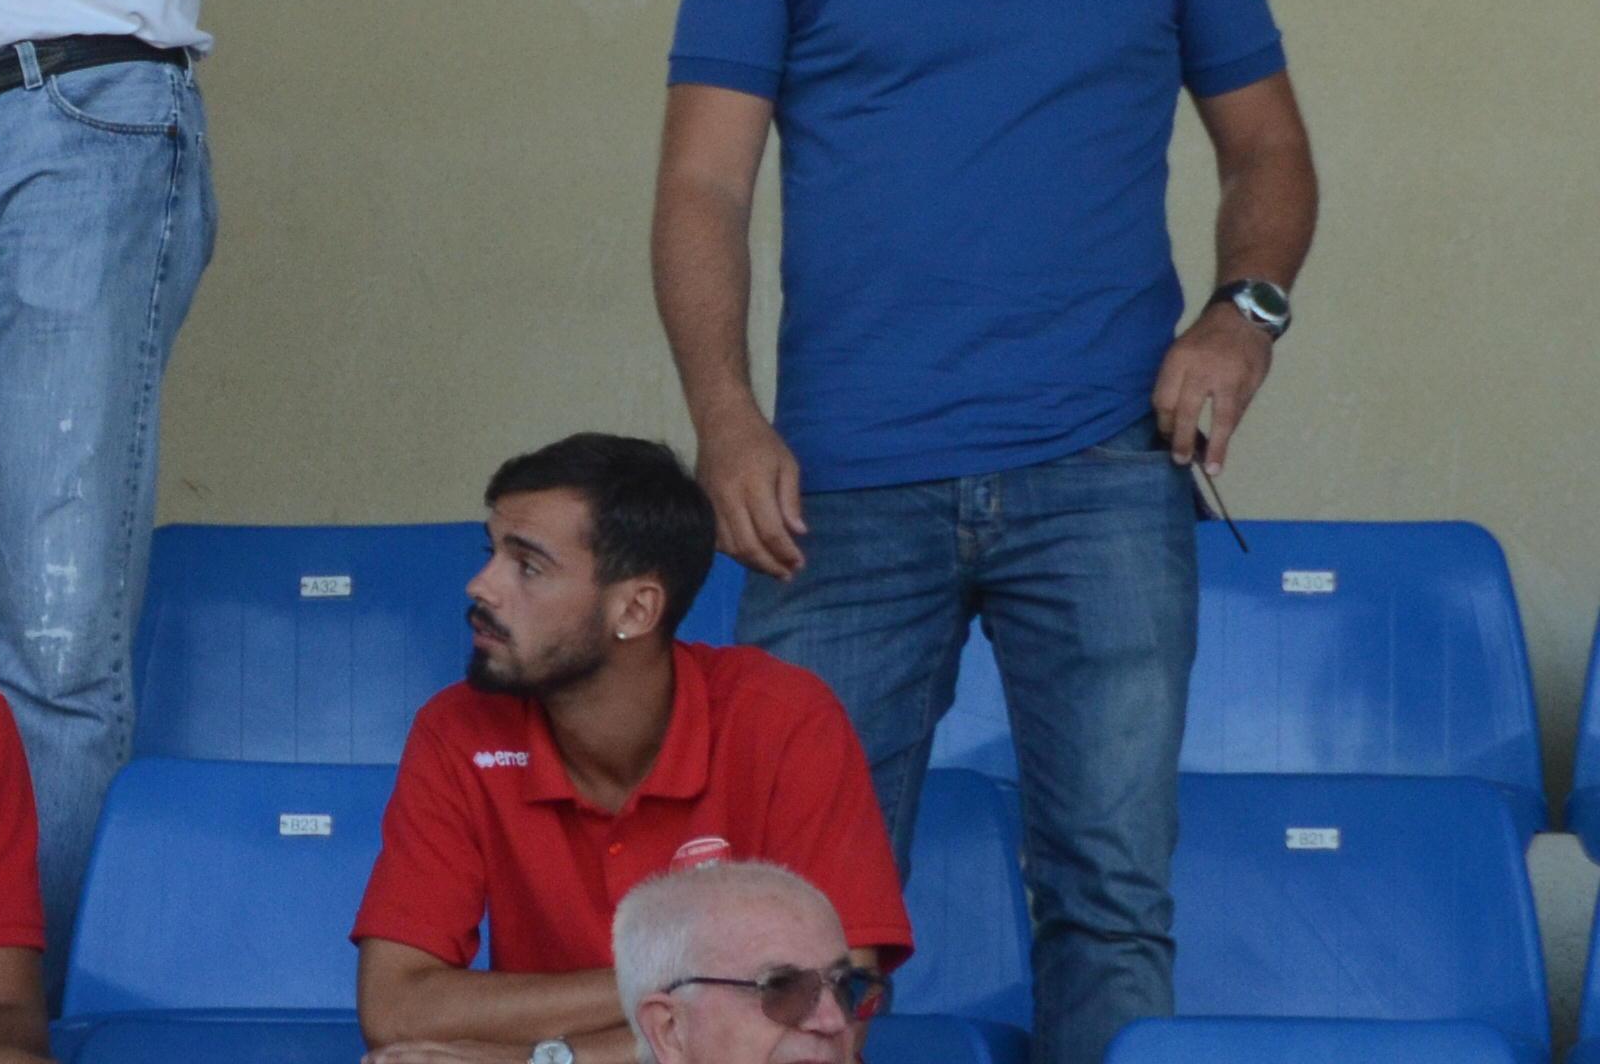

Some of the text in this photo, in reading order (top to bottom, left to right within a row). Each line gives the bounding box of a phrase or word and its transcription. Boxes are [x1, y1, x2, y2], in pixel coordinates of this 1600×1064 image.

[310, 580, 337, 593] A32
[1290, 576, 1324, 589] A30
[494, 750, 529, 766] erre
[290, 818, 319, 832] B23
[1299, 832, 1324, 845] B21
